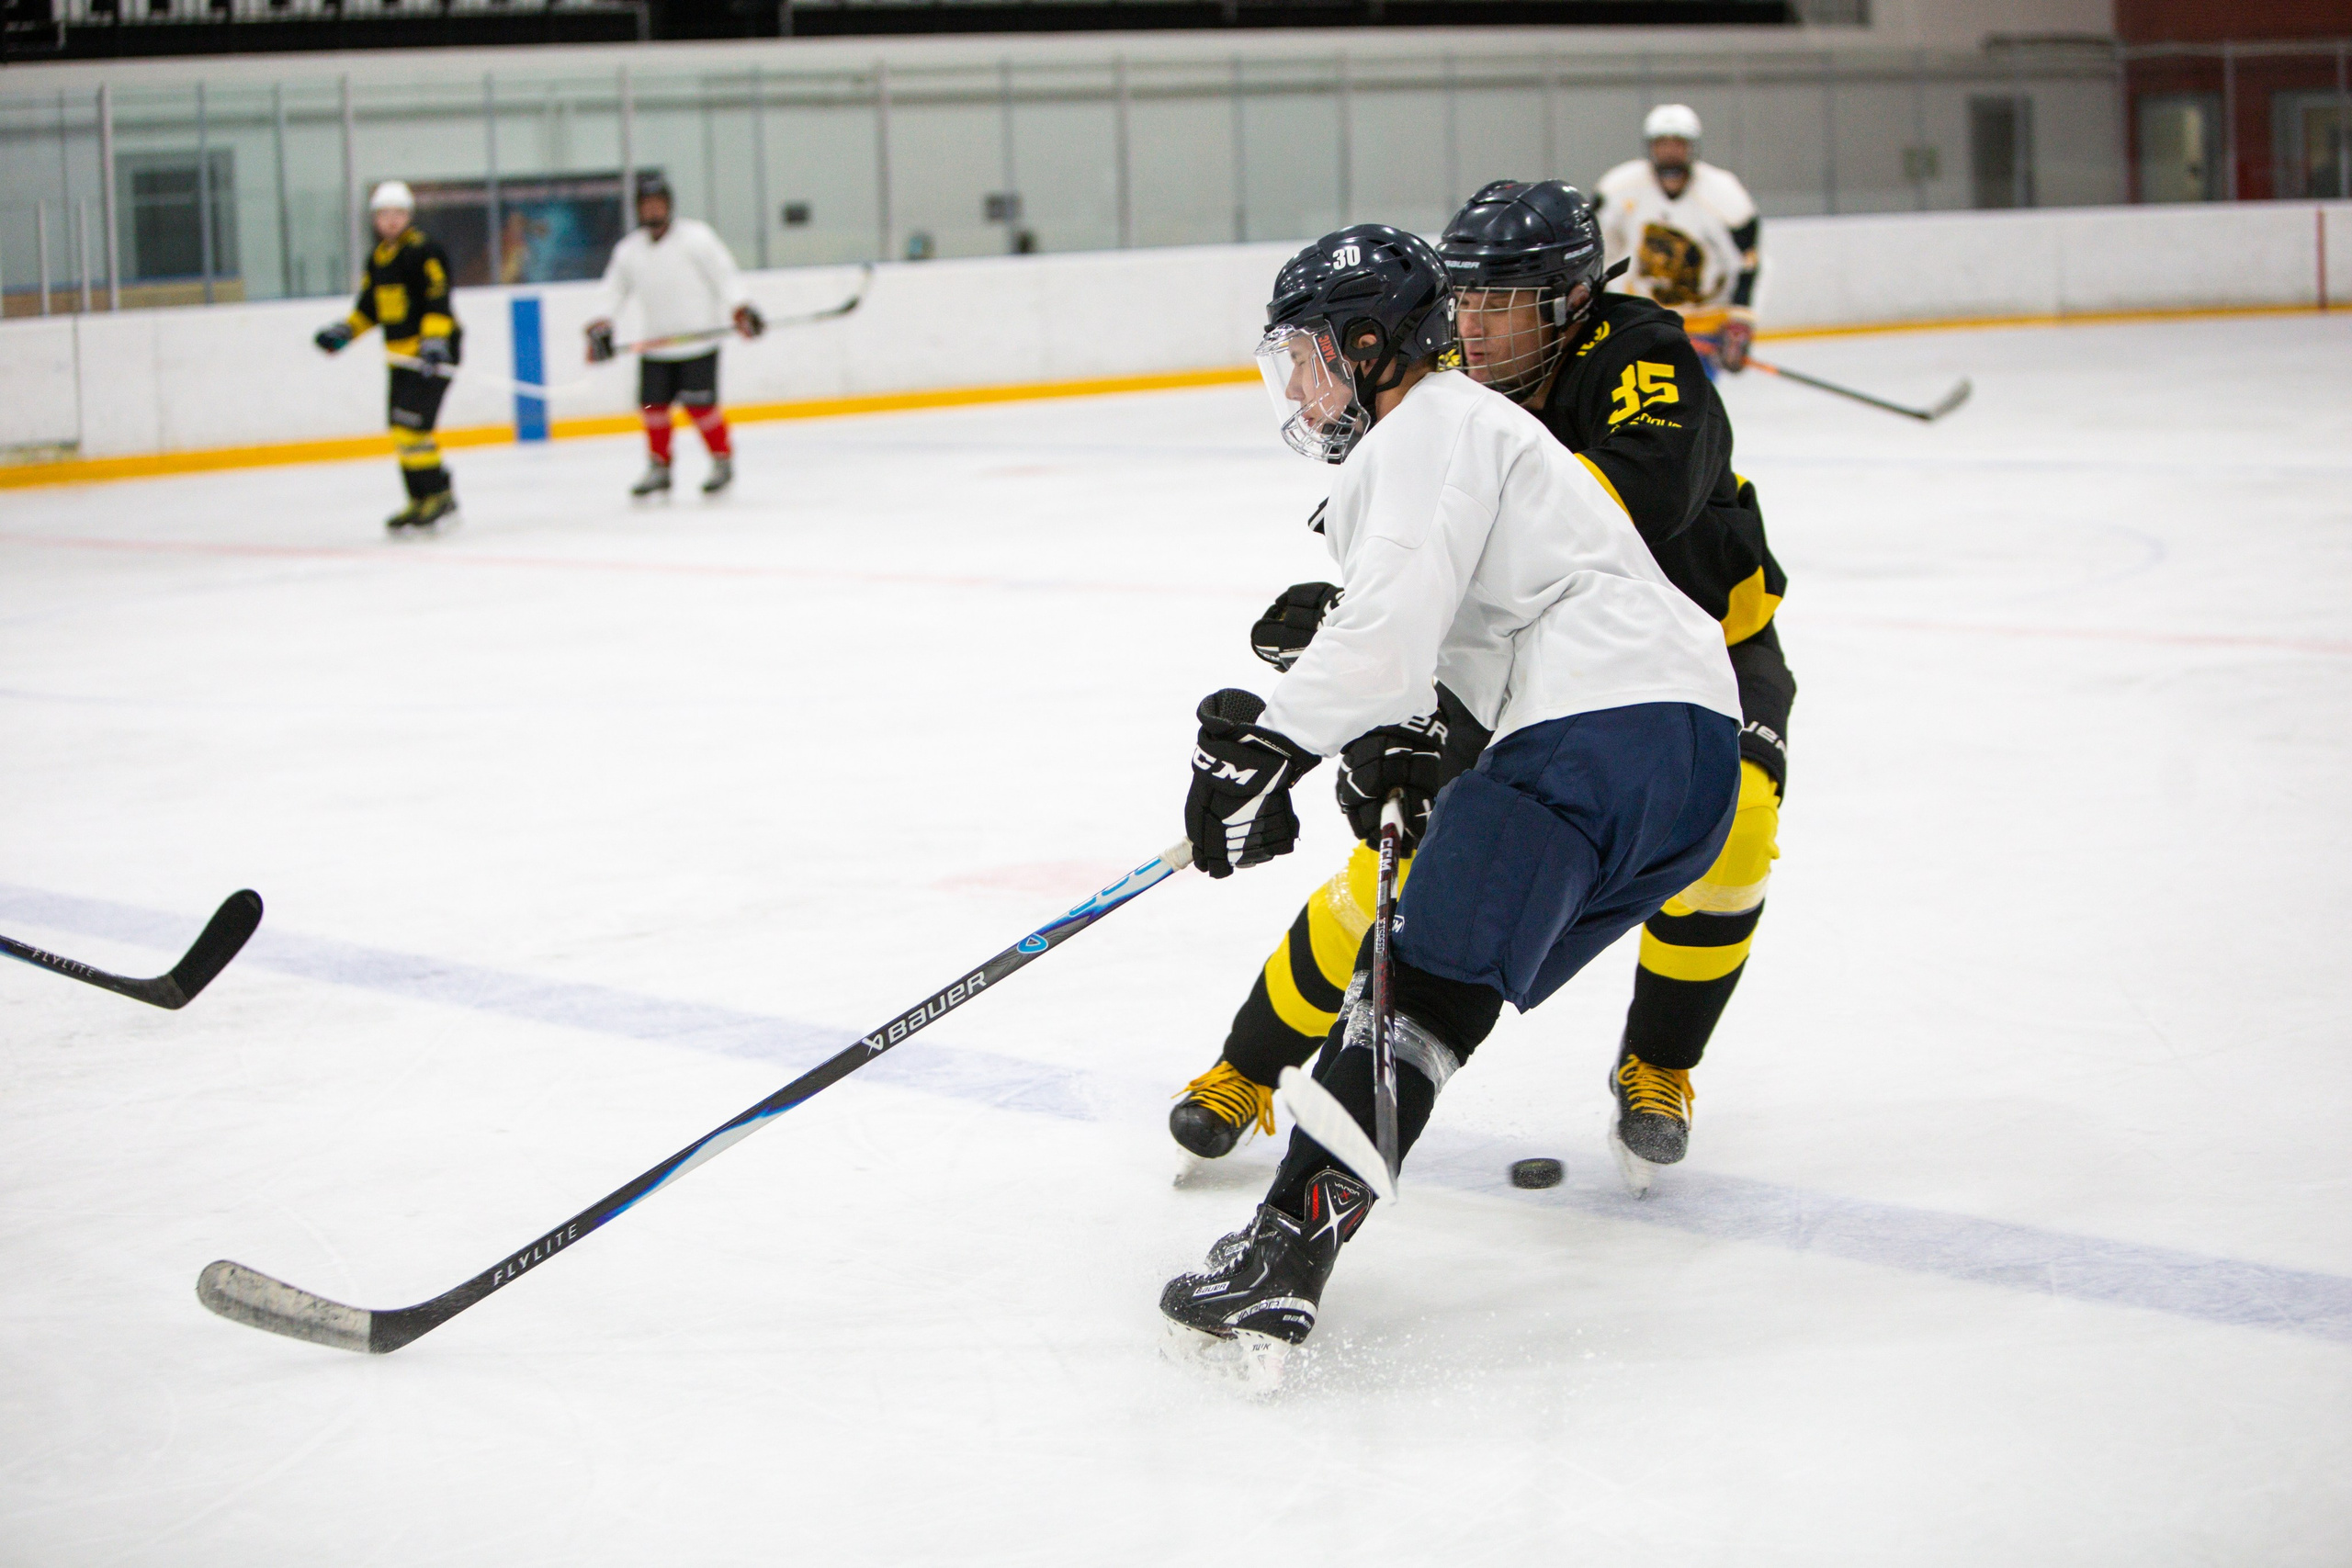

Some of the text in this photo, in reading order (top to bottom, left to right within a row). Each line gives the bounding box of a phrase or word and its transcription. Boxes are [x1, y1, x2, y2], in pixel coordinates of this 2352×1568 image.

[1332, 245, 1361, 270] 30
[1317, 334, 1337, 363] YARIC
[1608, 360, 1679, 424] 35
[1400, 716, 1449, 745] ER
[1193, 744, 1259, 785] CM
[1379, 837, 1394, 871] CCM
[32, 949, 96, 977] FLYLITE
[888, 970, 988, 1044] BAUER
[1334, 1181, 1360, 1197] VAPOR
[492, 1223, 578, 1287] FLYLITE
[1194, 1283, 1227, 1294] BAUER
